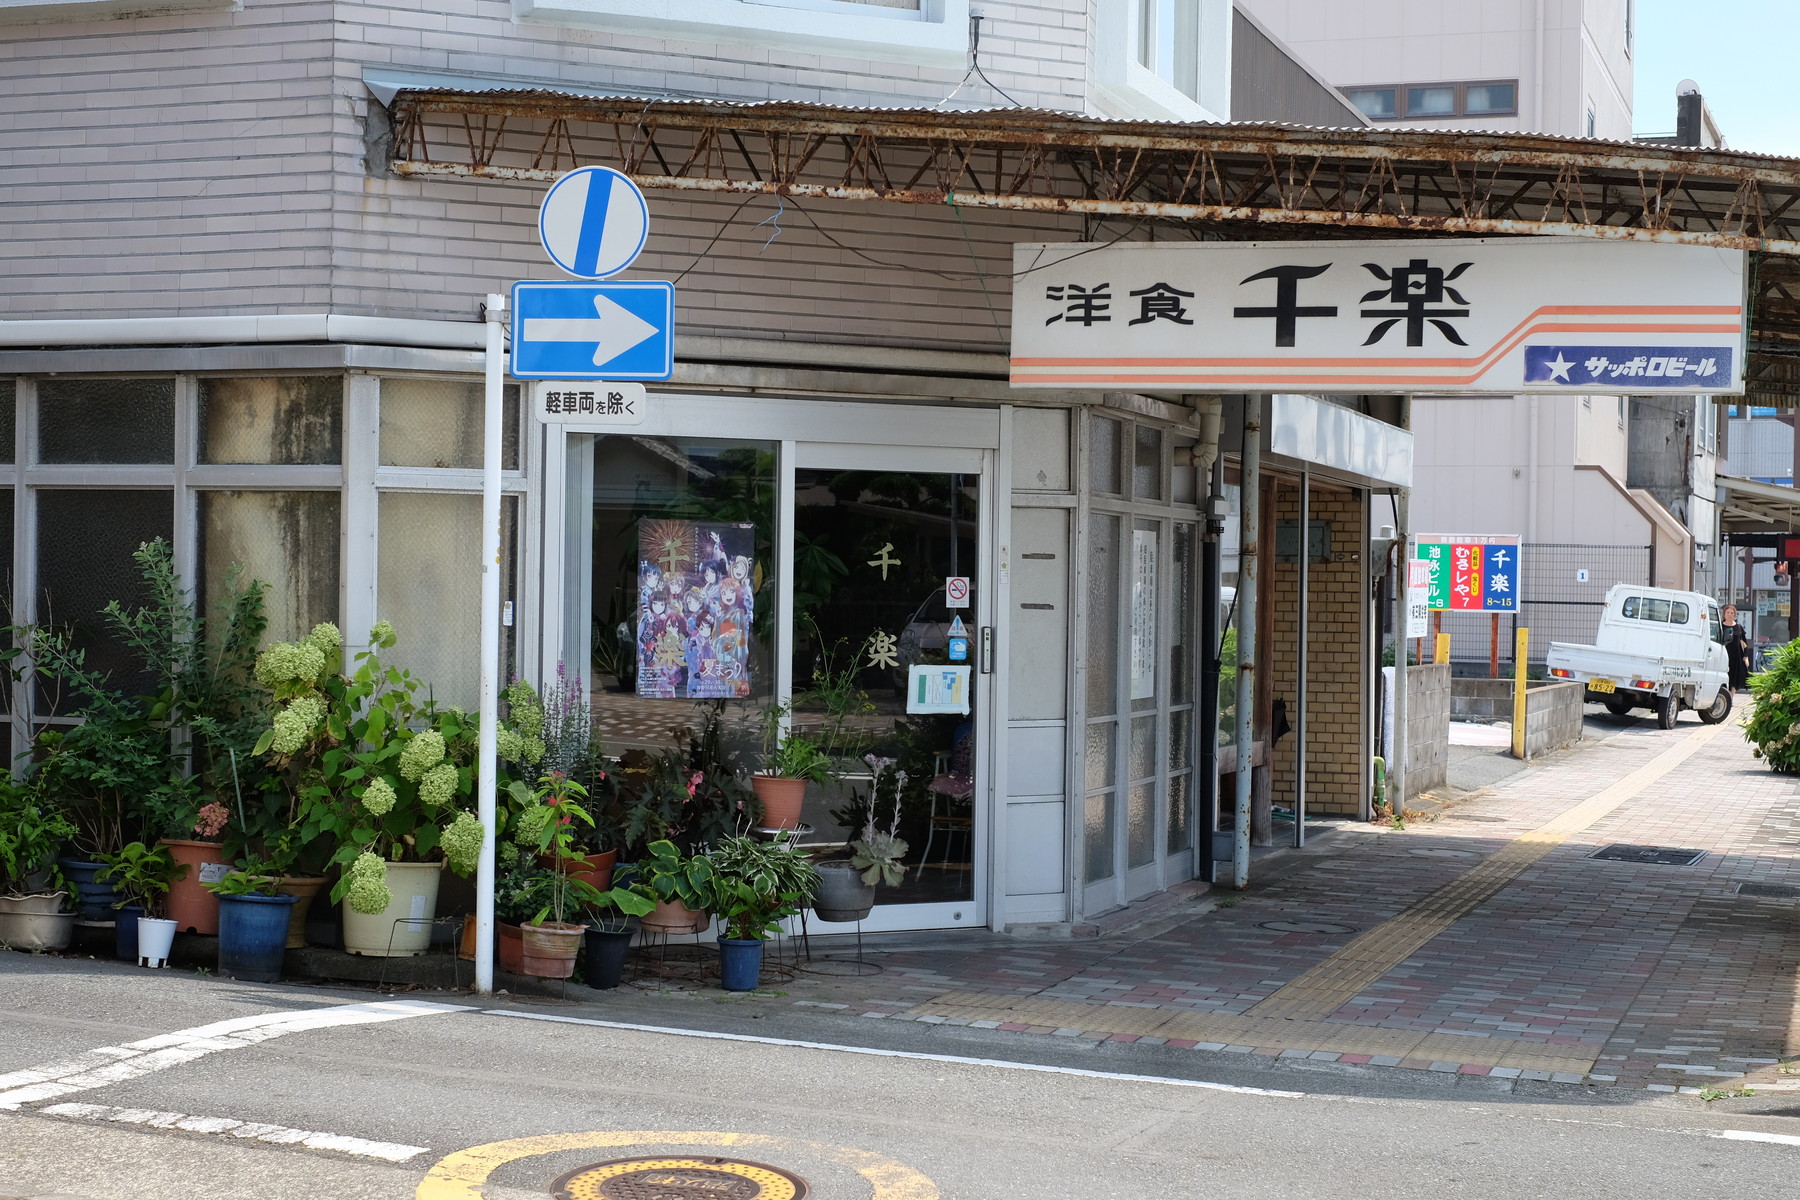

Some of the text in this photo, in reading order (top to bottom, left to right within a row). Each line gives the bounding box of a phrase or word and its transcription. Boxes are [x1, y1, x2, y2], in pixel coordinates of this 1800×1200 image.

[1045, 258, 1475, 348] 洋食 千楽
[1583, 354, 1718, 379] サッポロビール
[545, 391, 635, 415] 軽車両を除く
[1428, 545, 1441, 597] 池永ビル
[1454, 546, 1470, 596] むさしや
[1490, 549, 1510, 593] 千楽
[1580, 572, 1585, 580] 1
[867, 542, 902, 670] 千楽
[1462, 597, 1470, 607] 7
[701, 658, 742, 680] 夏まつり
